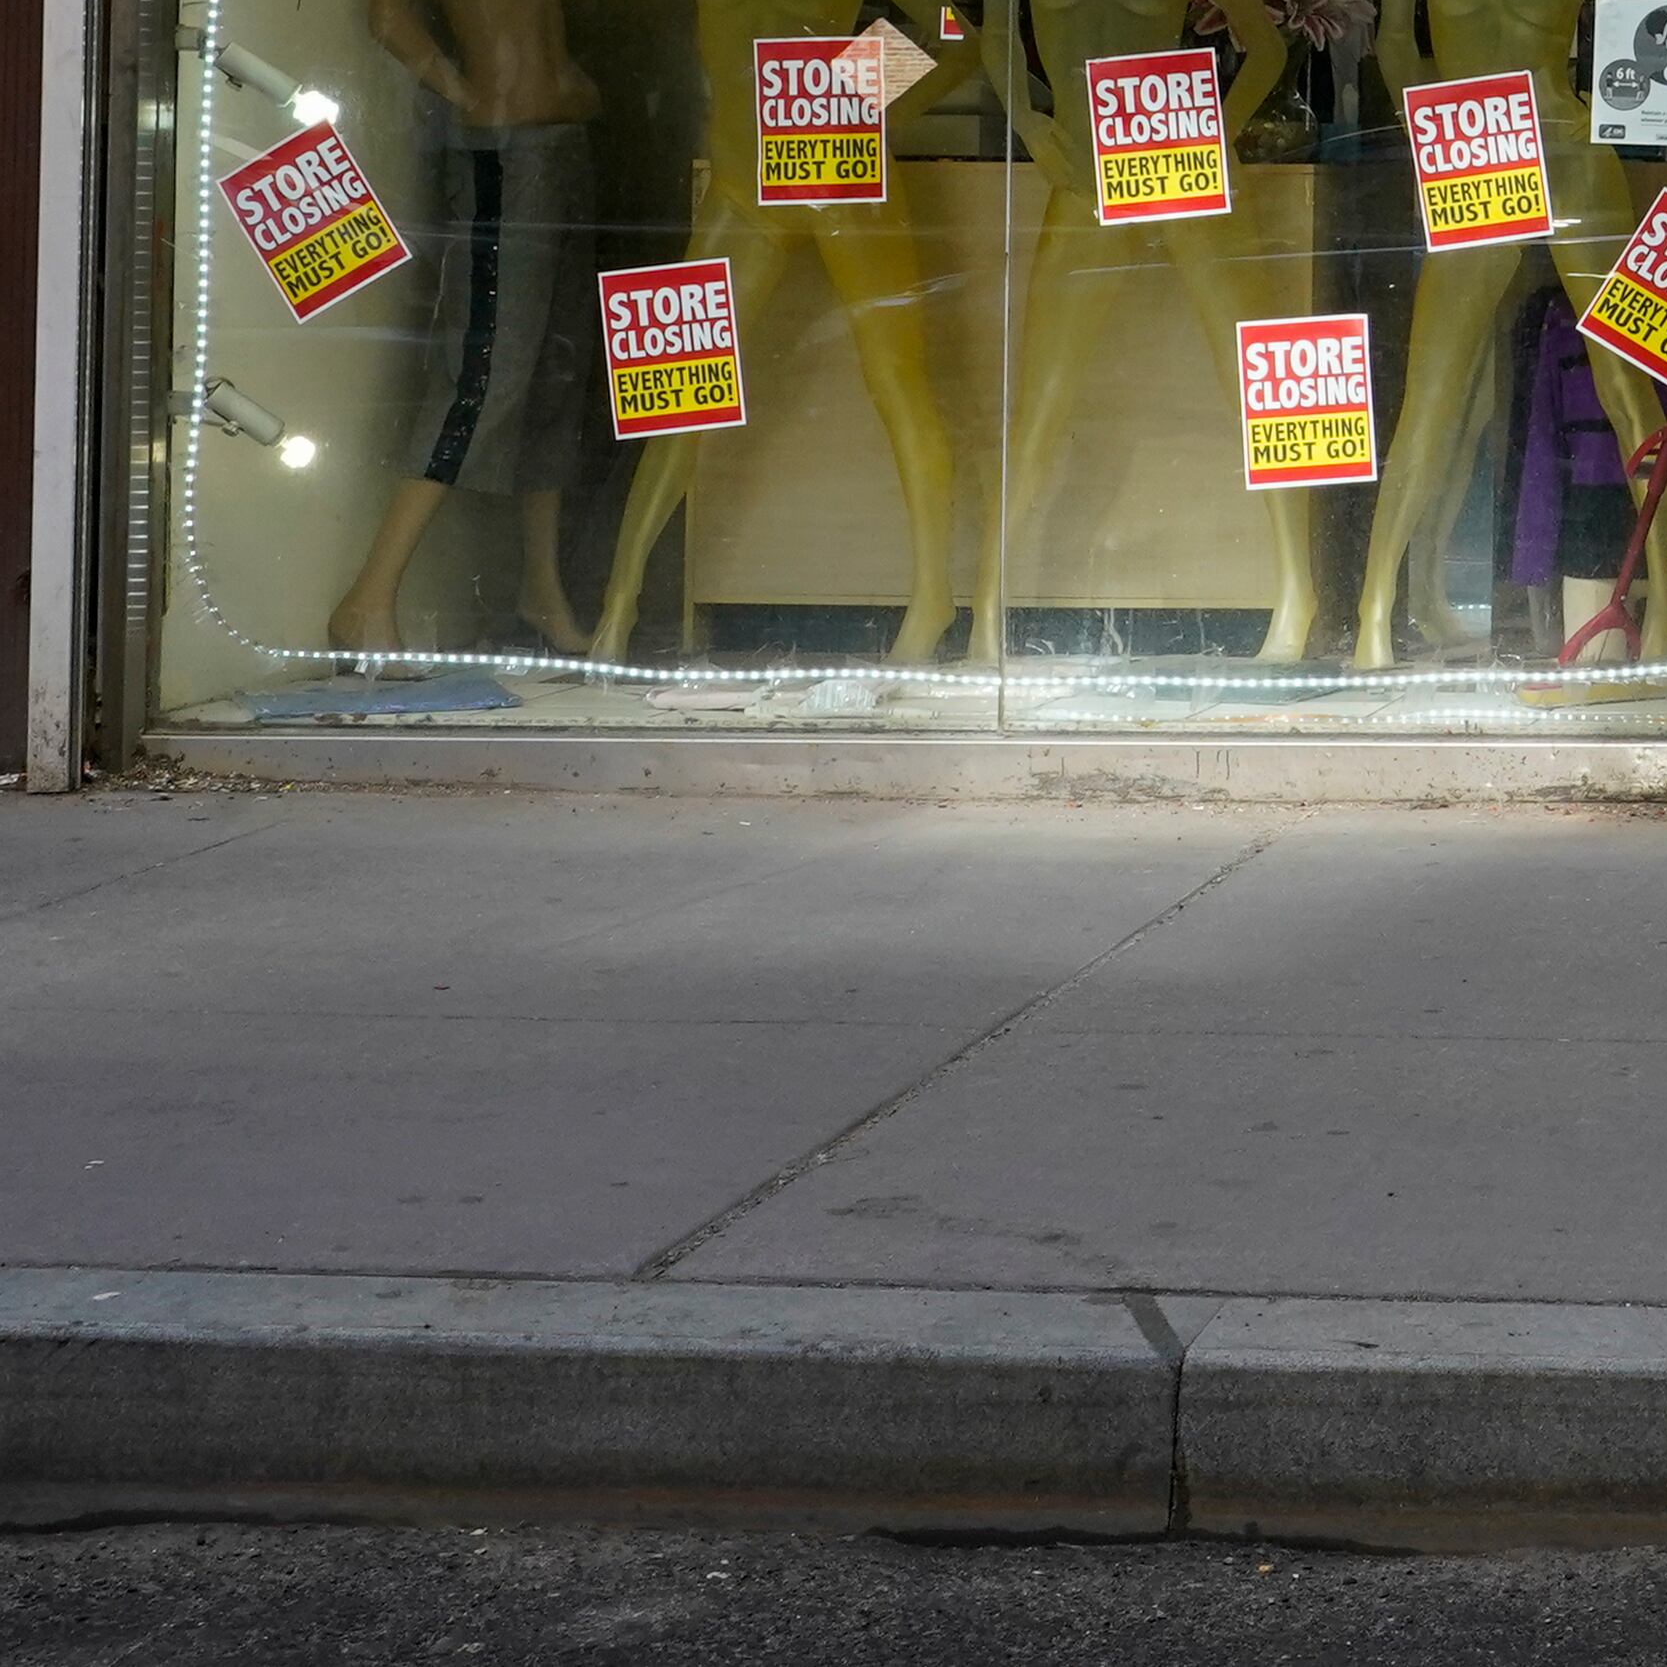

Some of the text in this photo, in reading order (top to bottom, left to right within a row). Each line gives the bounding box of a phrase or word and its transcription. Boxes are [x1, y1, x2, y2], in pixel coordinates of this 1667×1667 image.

[761, 58, 879, 97] STORE
[1616, 67, 1635, 80] 6 ft
[762, 97, 880, 127] CLOSING
[1096, 70, 1215, 116] STORE
[1098, 108, 1218, 147] CLOSING
[1413, 92, 1533, 144] STORE
[765, 138, 877, 160] EVERYTHING
[1104, 150, 1217, 179] EVERYTHING
[1419, 131, 1537, 174] CLOSING
[236, 136, 351, 224] STORE
[766, 159, 876, 181] MUST GO!
[1107, 172, 1218, 200] MUST GO!
[1426, 172, 1539, 207] EVERYTHING
[254, 171, 367, 251] CLOSING
[1431, 193, 1541, 227] MUST GO!
[274, 207, 382, 281] EVERYTHING
[286, 226, 391, 299] MUST GO!
[608, 281, 729, 330] STORE
[1597, 299, 1658, 342] MUST
[611, 319, 732, 360] CLOSING
[1246, 336, 1364, 380] STORE
[617, 362, 732, 393] EVERYTHING
[1247, 374, 1366, 411] CLOSING
[621, 384, 734, 414] MUST GO!
[1252, 417, 1366, 444] EVERYTHING
[1253, 439, 1366, 465] MUST GO!
